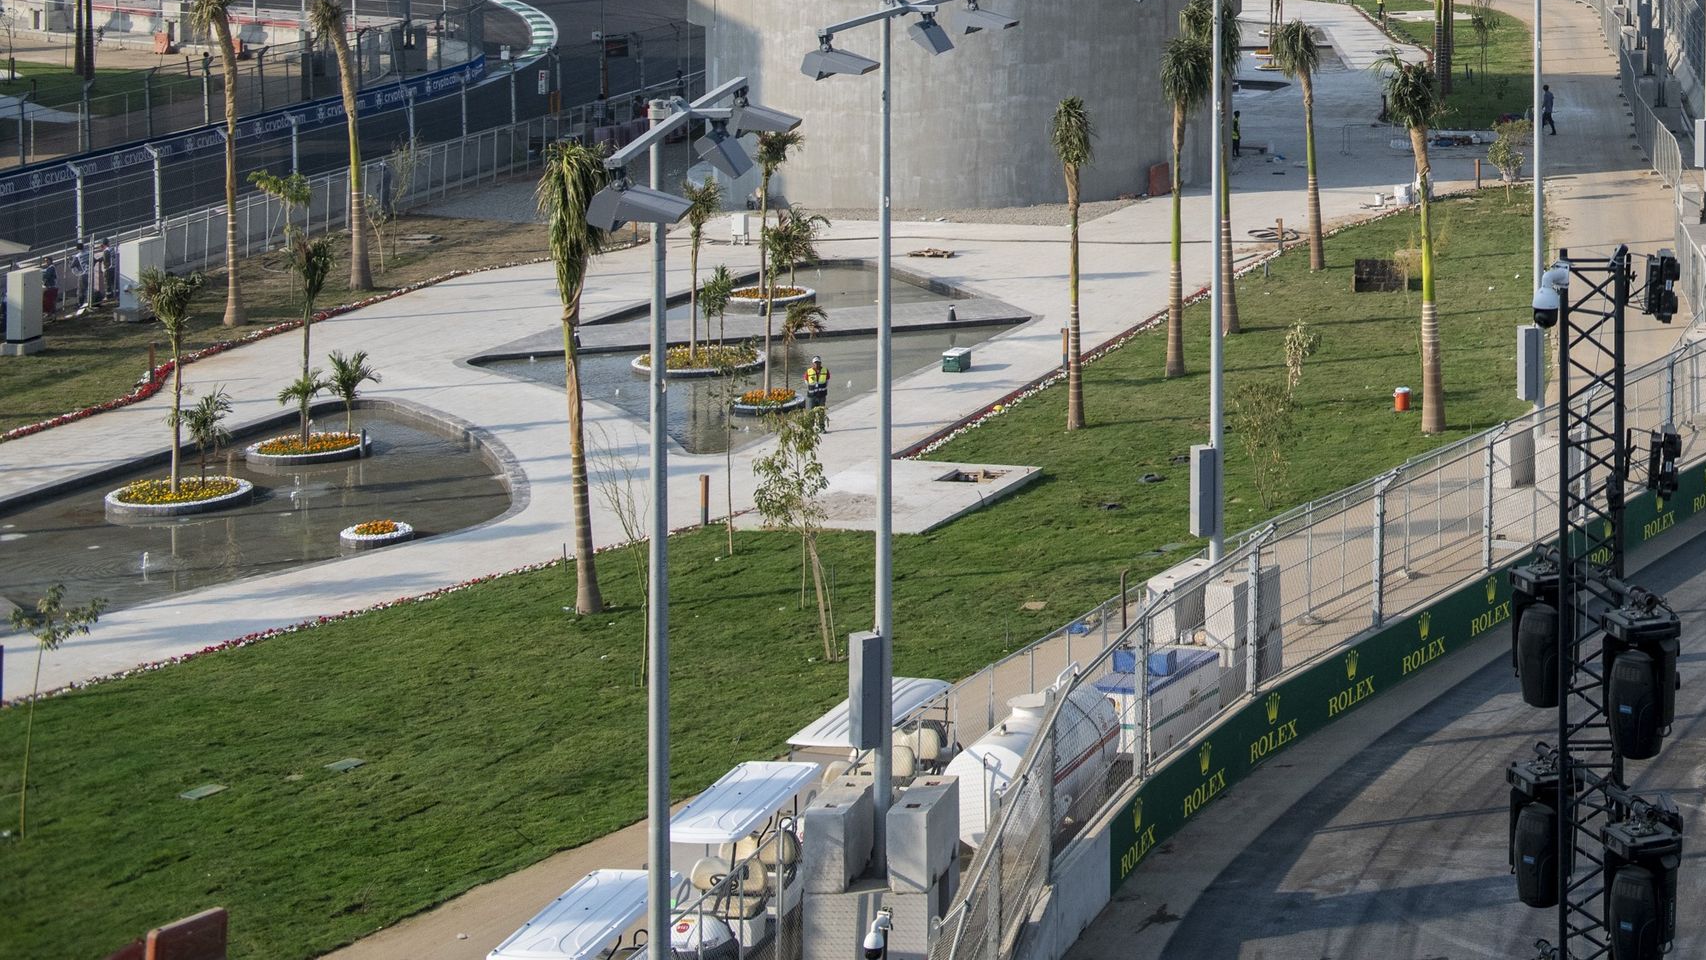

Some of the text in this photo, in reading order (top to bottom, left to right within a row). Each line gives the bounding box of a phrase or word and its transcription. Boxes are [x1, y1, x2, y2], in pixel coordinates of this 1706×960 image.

[1643, 510, 1675, 540] ROLEX
[1471, 600, 1510, 637] ROLEX
[1402, 636, 1445, 675] ROLEX
[1328, 675, 1375, 717] ROLEX
[1250, 718, 1298, 764] ROLEX
[1184, 768, 1226, 818] ROLEX
[1120, 824, 1156, 878] ROLEX
